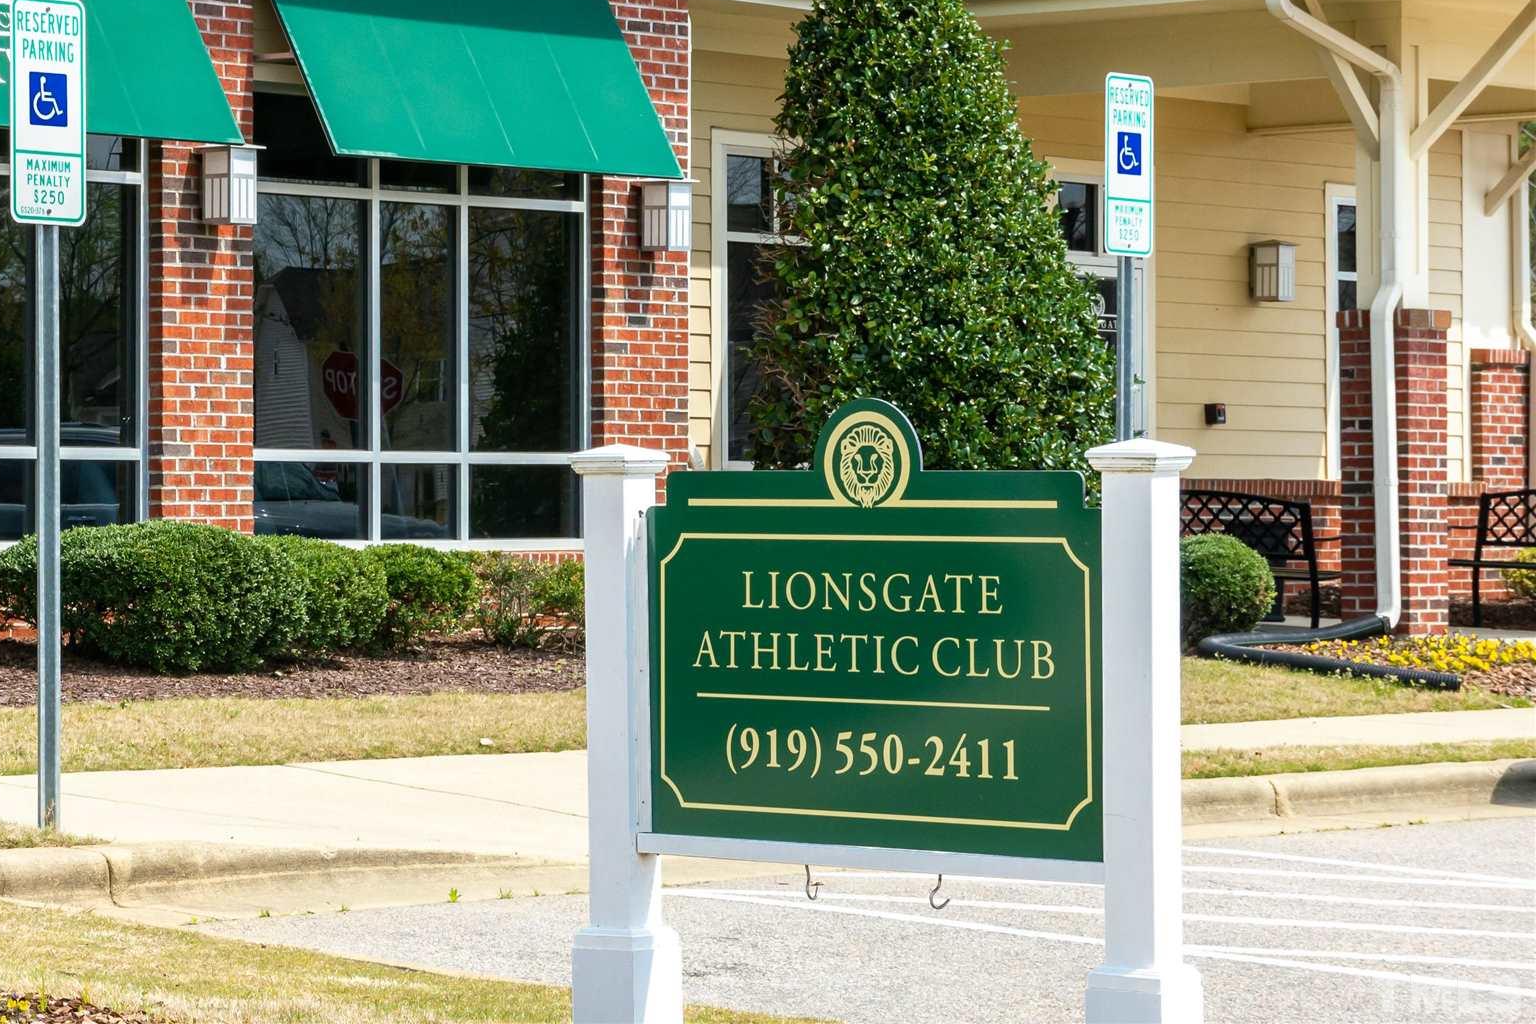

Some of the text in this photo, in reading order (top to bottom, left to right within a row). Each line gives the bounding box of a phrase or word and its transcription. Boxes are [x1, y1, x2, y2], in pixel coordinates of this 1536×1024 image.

[17, 9, 79, 36] RESERVED
[22, 38, 75, 63] PARKING
[1110, 86, 1149, 108] RESERVED
[1113, 109, 1146, 129] PARKING
[26, 159, 71, 173] MAXIMUM
[27, 173, 71, 188] PENALTY
[33, 189, 65, 205] $250
[741, 571, 1003, 615] LIONSGATE
[692, 630, 1056, 679] ATHLETIC CLUB
[726, 723, 1019, 780] (919) 550-2411
